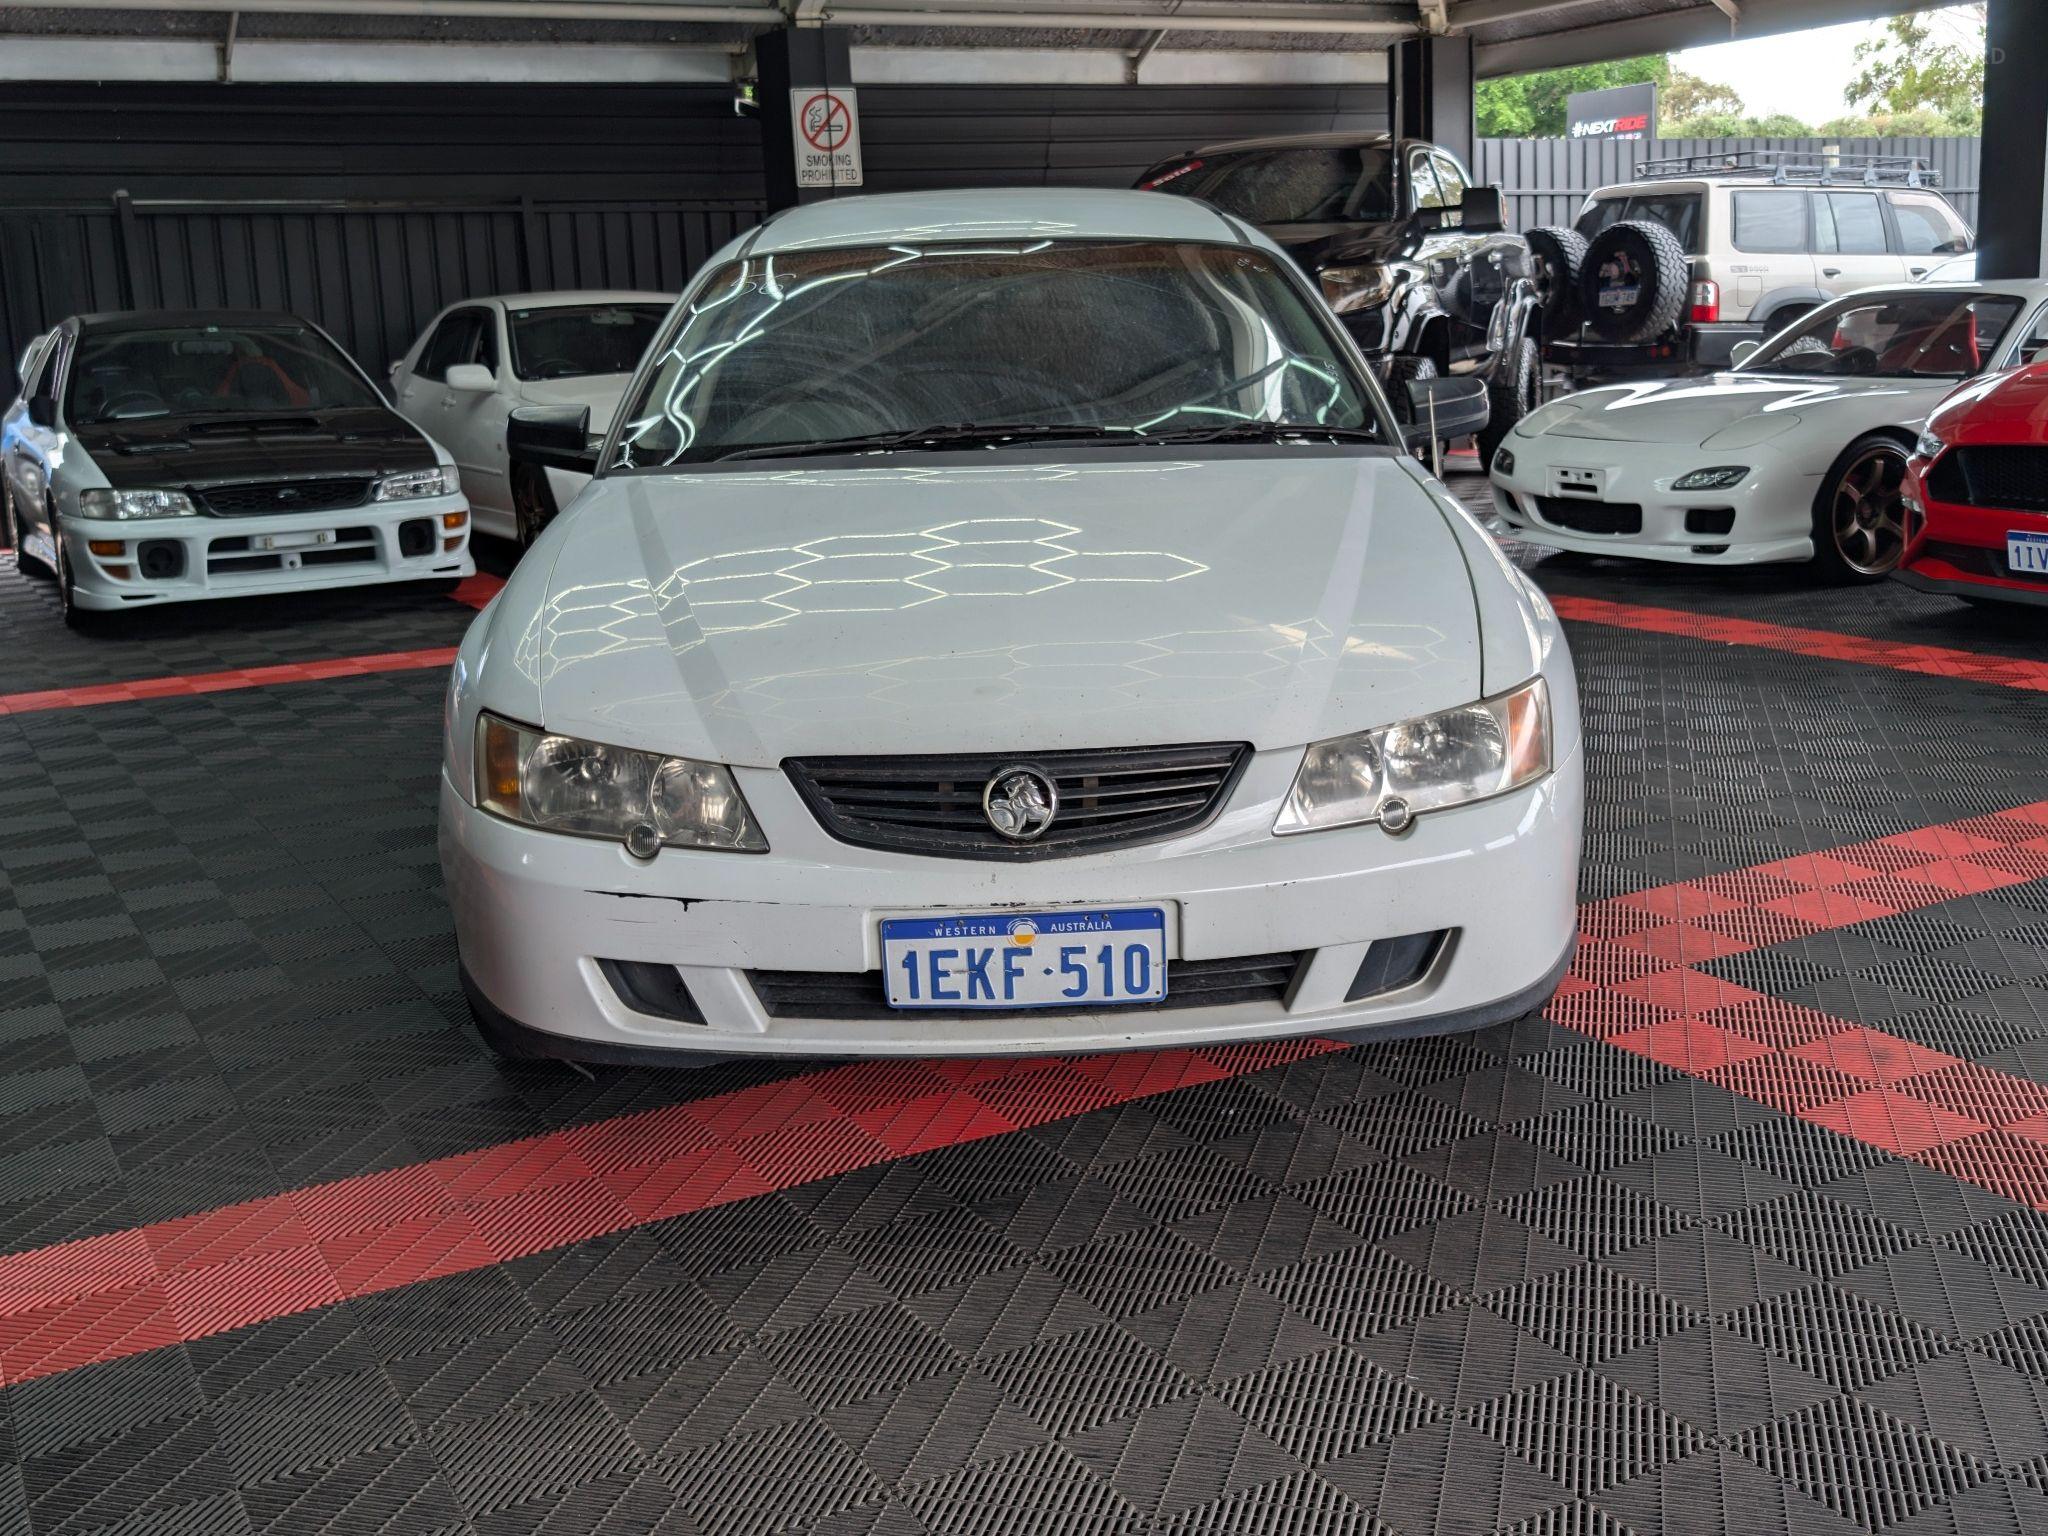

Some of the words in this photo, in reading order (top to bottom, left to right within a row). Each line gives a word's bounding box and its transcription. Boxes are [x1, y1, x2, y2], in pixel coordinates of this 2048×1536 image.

[1572, 115, 1648, 138] #NEXTRIDE
[806, 154, 852, 167] SMOKING
[934, 925, 997, 937] WESTERN
[1050, 921, 1113, 932] AUSTRALIA
